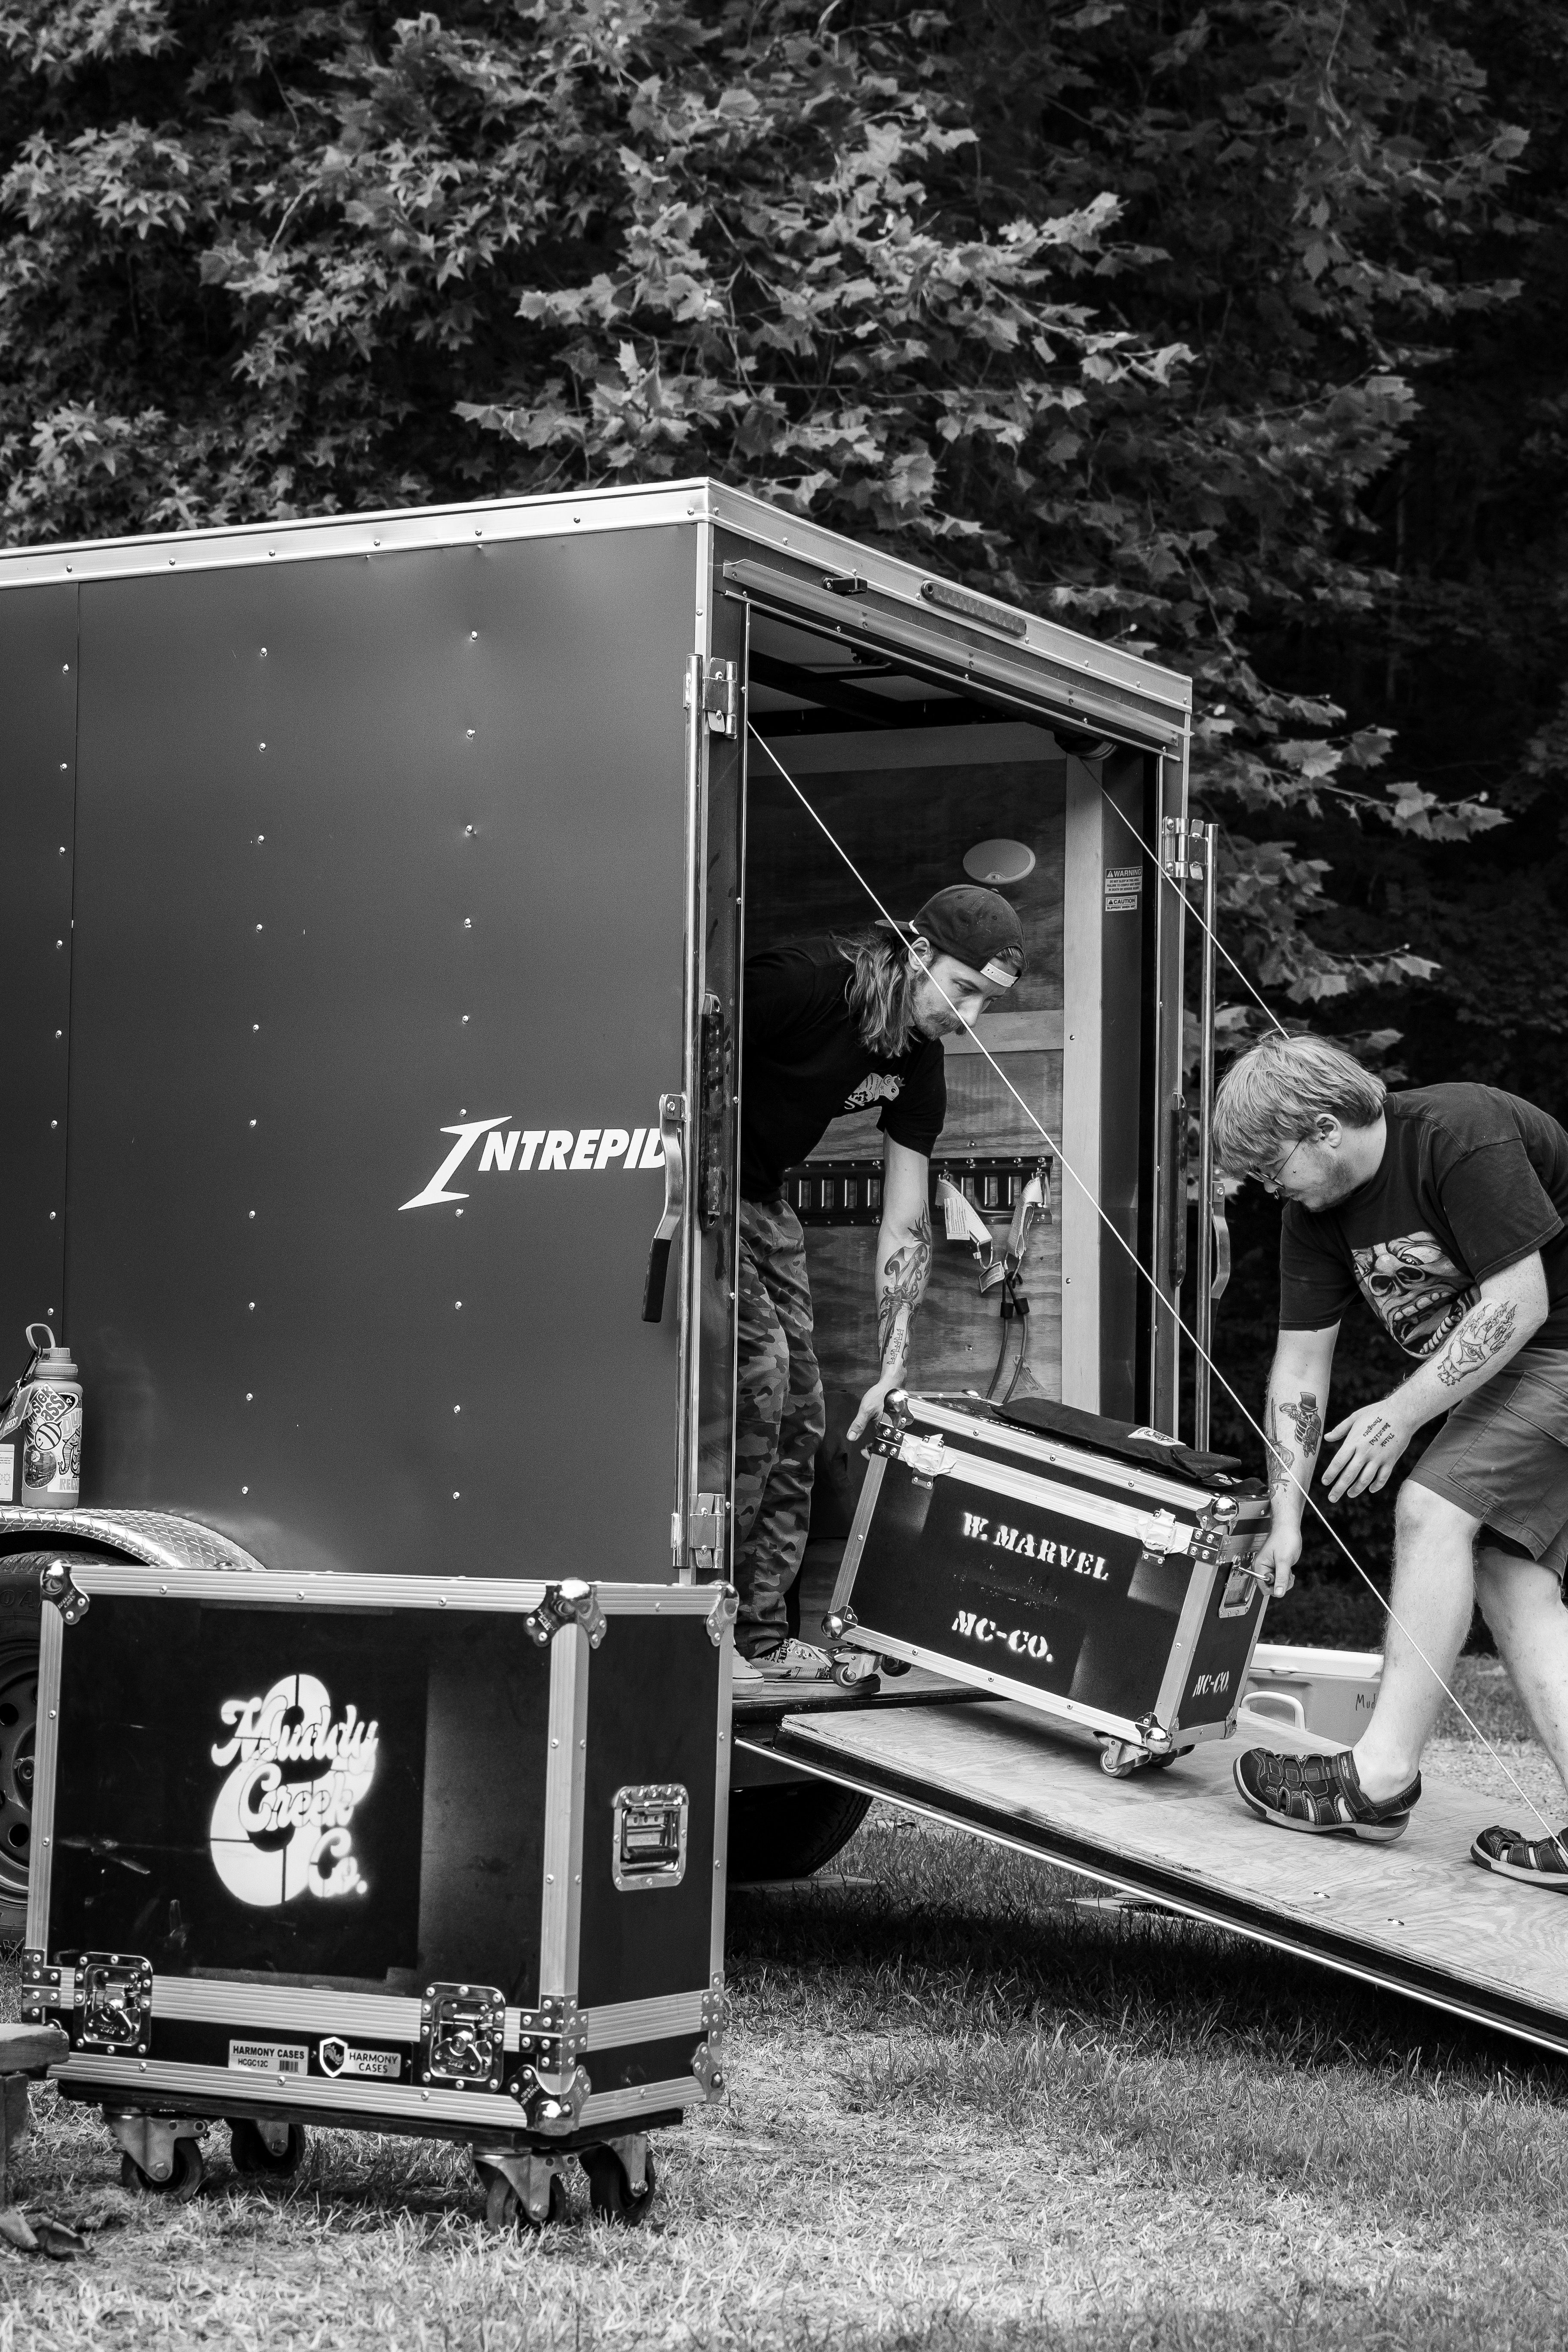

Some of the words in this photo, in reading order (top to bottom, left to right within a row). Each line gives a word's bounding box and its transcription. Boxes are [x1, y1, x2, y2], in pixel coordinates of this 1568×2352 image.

[1114, 869, 1141, 877] WARNING
[398, 1115, 668, 1211] INTREPID
[1363, 1416, 1382, 1437] Thoughts
[1369, 1422, 1391, 1446] Beautiful
[1380, 1433, 1395, 1447] Think
[993, 1525, 1109, 1581] MARVEL
[951, 1610, 1053, 1663] MC-CO.
[211, 1695, 379, 1775] Muddy
[238, 1762, 354, 1832] Creek
[307, 1827, 368, 1898] Co.
[233, 2045, 275, 2057] HARMONY
[277, 2049, 305, 2060] CASES
[238, 2058, 269, 2068] HCGC12C
[349, 2052, 399, 2064] HARMONY
[358, 2064, 388, 2073] CASES
